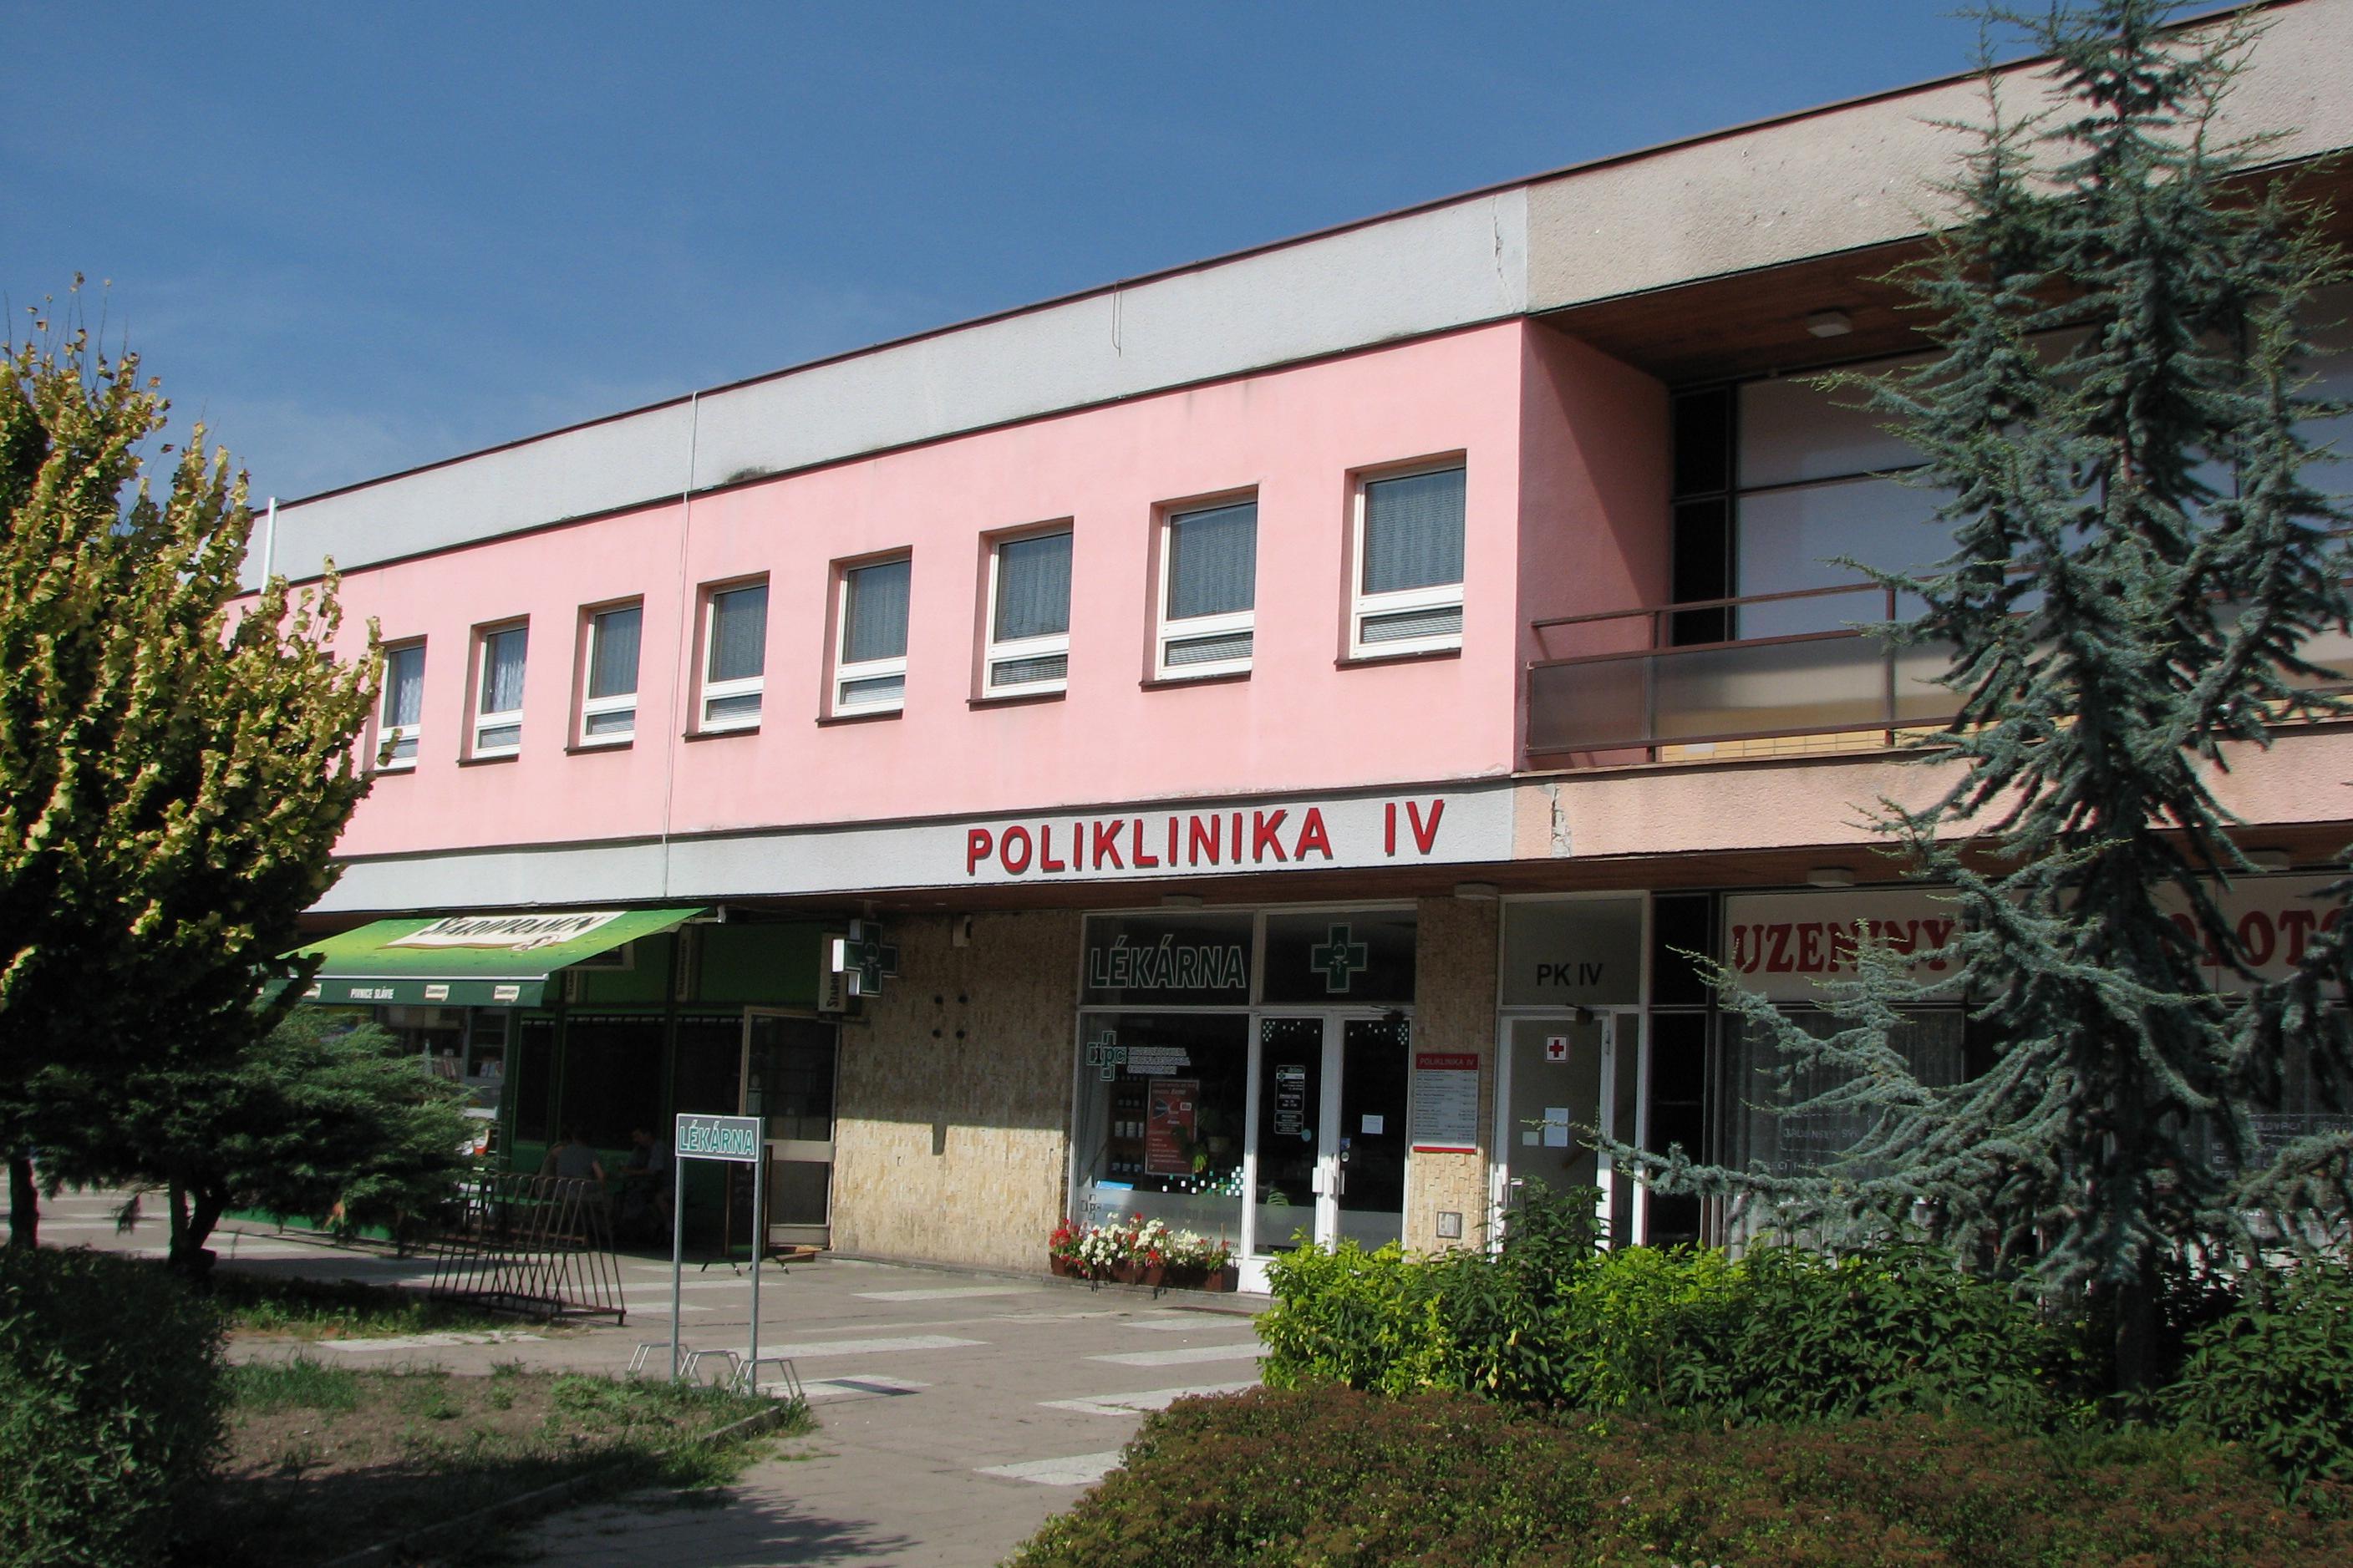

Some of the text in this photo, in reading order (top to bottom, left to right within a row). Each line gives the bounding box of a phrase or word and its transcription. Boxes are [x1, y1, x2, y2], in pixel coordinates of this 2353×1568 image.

[967, 799, 1443, 875] POLIKLINIKA IV
[1090, 933, 1246, 989] LÉKÁRNA
[1537, 963, 1603, 987] PK IV
[678, 1119, 755, 1156] LÉKÁRNA
